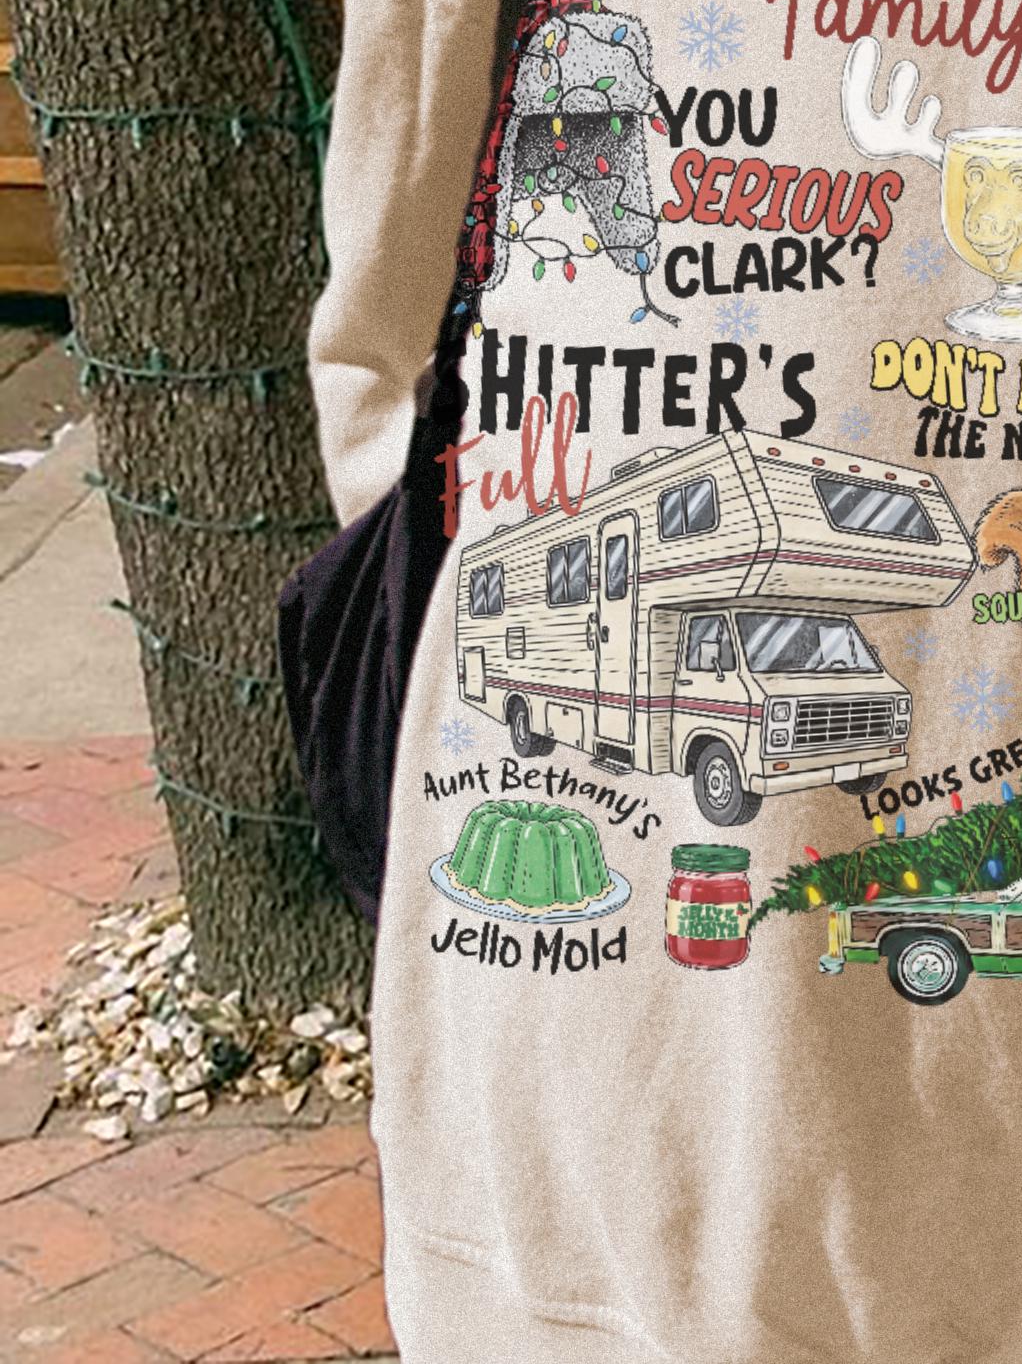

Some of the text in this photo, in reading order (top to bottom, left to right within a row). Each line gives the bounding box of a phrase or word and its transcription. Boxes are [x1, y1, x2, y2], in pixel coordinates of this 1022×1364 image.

[654, 86, 778, 148] YOU
[661, 148, 904, 242] SERIOUS
[664, 235, 881, 298] CLARK?
[456, 326, 818, 437] HITTER'S
[870, 337, 1005, 418] DON'T
[434, 391, 593, 540] Full
[914, 405, 988, 459] THE
[424, 756, 662, 841] Aunt Bethany's
[860, 764, 963, 821] LOOKS
[431, 918, 627, 976] Jello Mold
